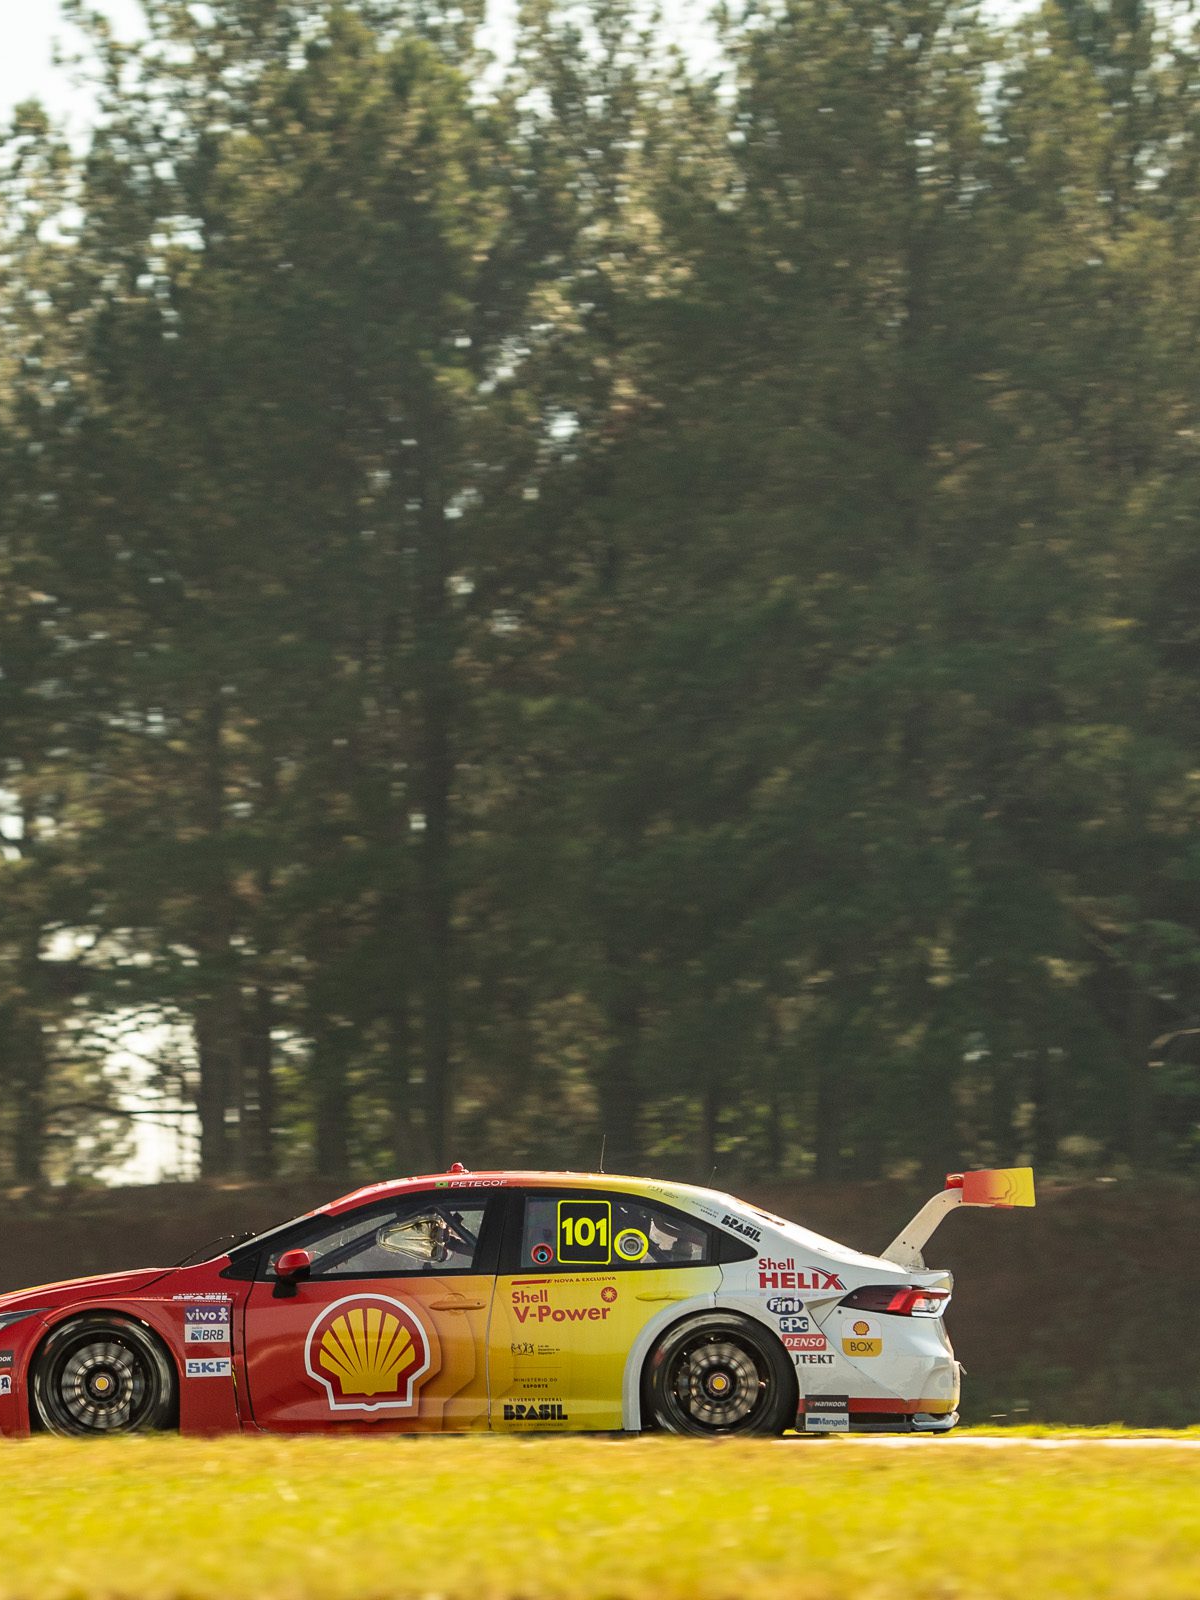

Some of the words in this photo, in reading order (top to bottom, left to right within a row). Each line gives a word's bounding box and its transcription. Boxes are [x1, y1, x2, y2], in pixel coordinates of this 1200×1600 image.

[450, 1179, 508, 1188] PETECOF
[561, 1217, 607, 1247] 101
[721, 1214, 761, 1243] BRASIL
[758, 1258, 795, 1271] Shell
[758, 1272, 844, 1291] HELIX
[511, 1289, 548, 1304] Shell
[769, 1298, 800, 1313] Fini
[186, 1308, 217, 1321] vivo
[513, 1305, 611, 1323] V-Power
[780, 1317, 808, 1332] PPG
[202, 1329, 224, 1341] BRB
[785, 1337, 825, 1348] DENSO
[850, 1341, 874, 1352] BOX
[795, 1354, 835, 1365] JTEKT
[187, 1361, 229, 1373] SKF
[503, 1404, 569, 1421] BRASIL
[820, 1418, 848, 1426] Mangels
